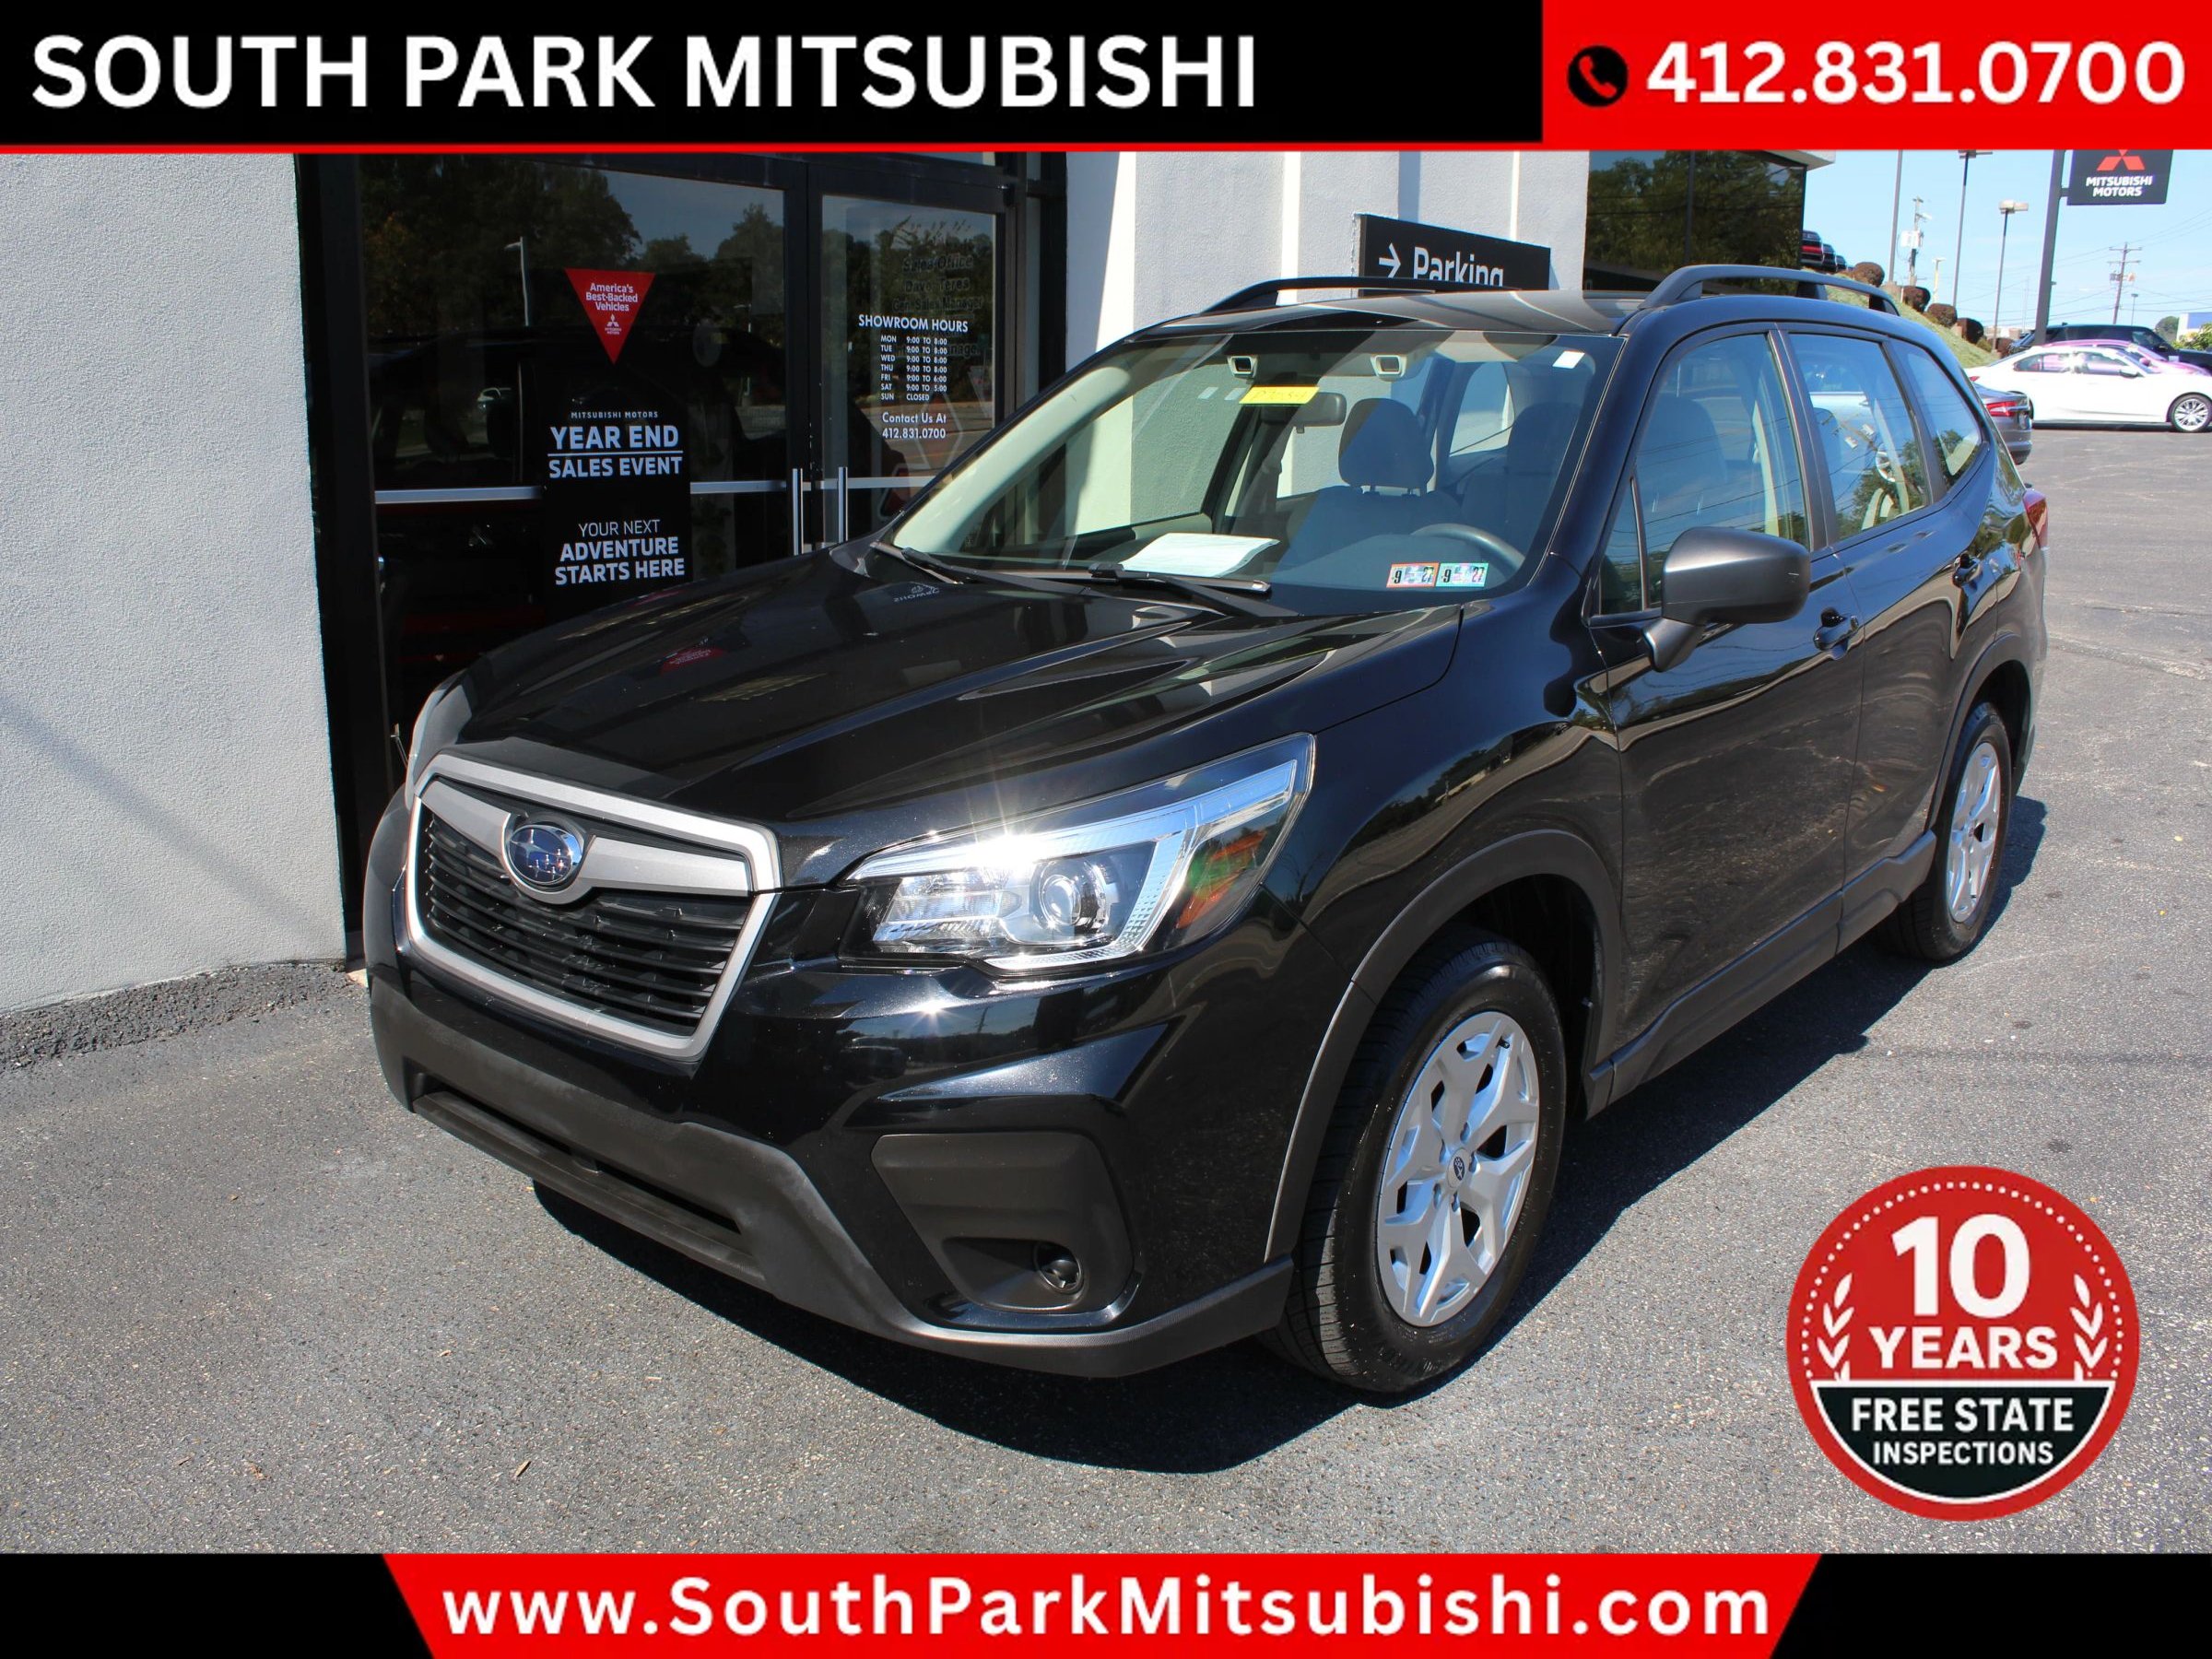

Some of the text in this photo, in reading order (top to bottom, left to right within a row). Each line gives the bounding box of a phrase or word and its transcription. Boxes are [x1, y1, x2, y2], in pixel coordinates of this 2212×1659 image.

[2086, 175, 2153, 187] MITSUBISHI
[2092, 186, 2143, 197] MOTORS
[590, 282, 634, 293] America's
[585, 291, 638, 302] Best-Backed
[595, 301, 629, 312] Vehicles
[858, 314, 969, 332] SHOWROOM HOURS
[571, 411, 621, 419] MITSUBISHI
[882, 412, 947, 424] Contact Us At
[550, 425, 679, 450] YEAR END
[882, 428, 946, 439] 412.831.0700
[548, 456, 683, 478] SALES EVENT
[578, 519, 661, 537] YOUR NEXT
[559, 536, 679, 562] ADVENTURE
[555, 558, 685, 585] STARTS HERE
[1394, 570, 1403, 583] 9
[1443, 569, 1453, 582] 9
